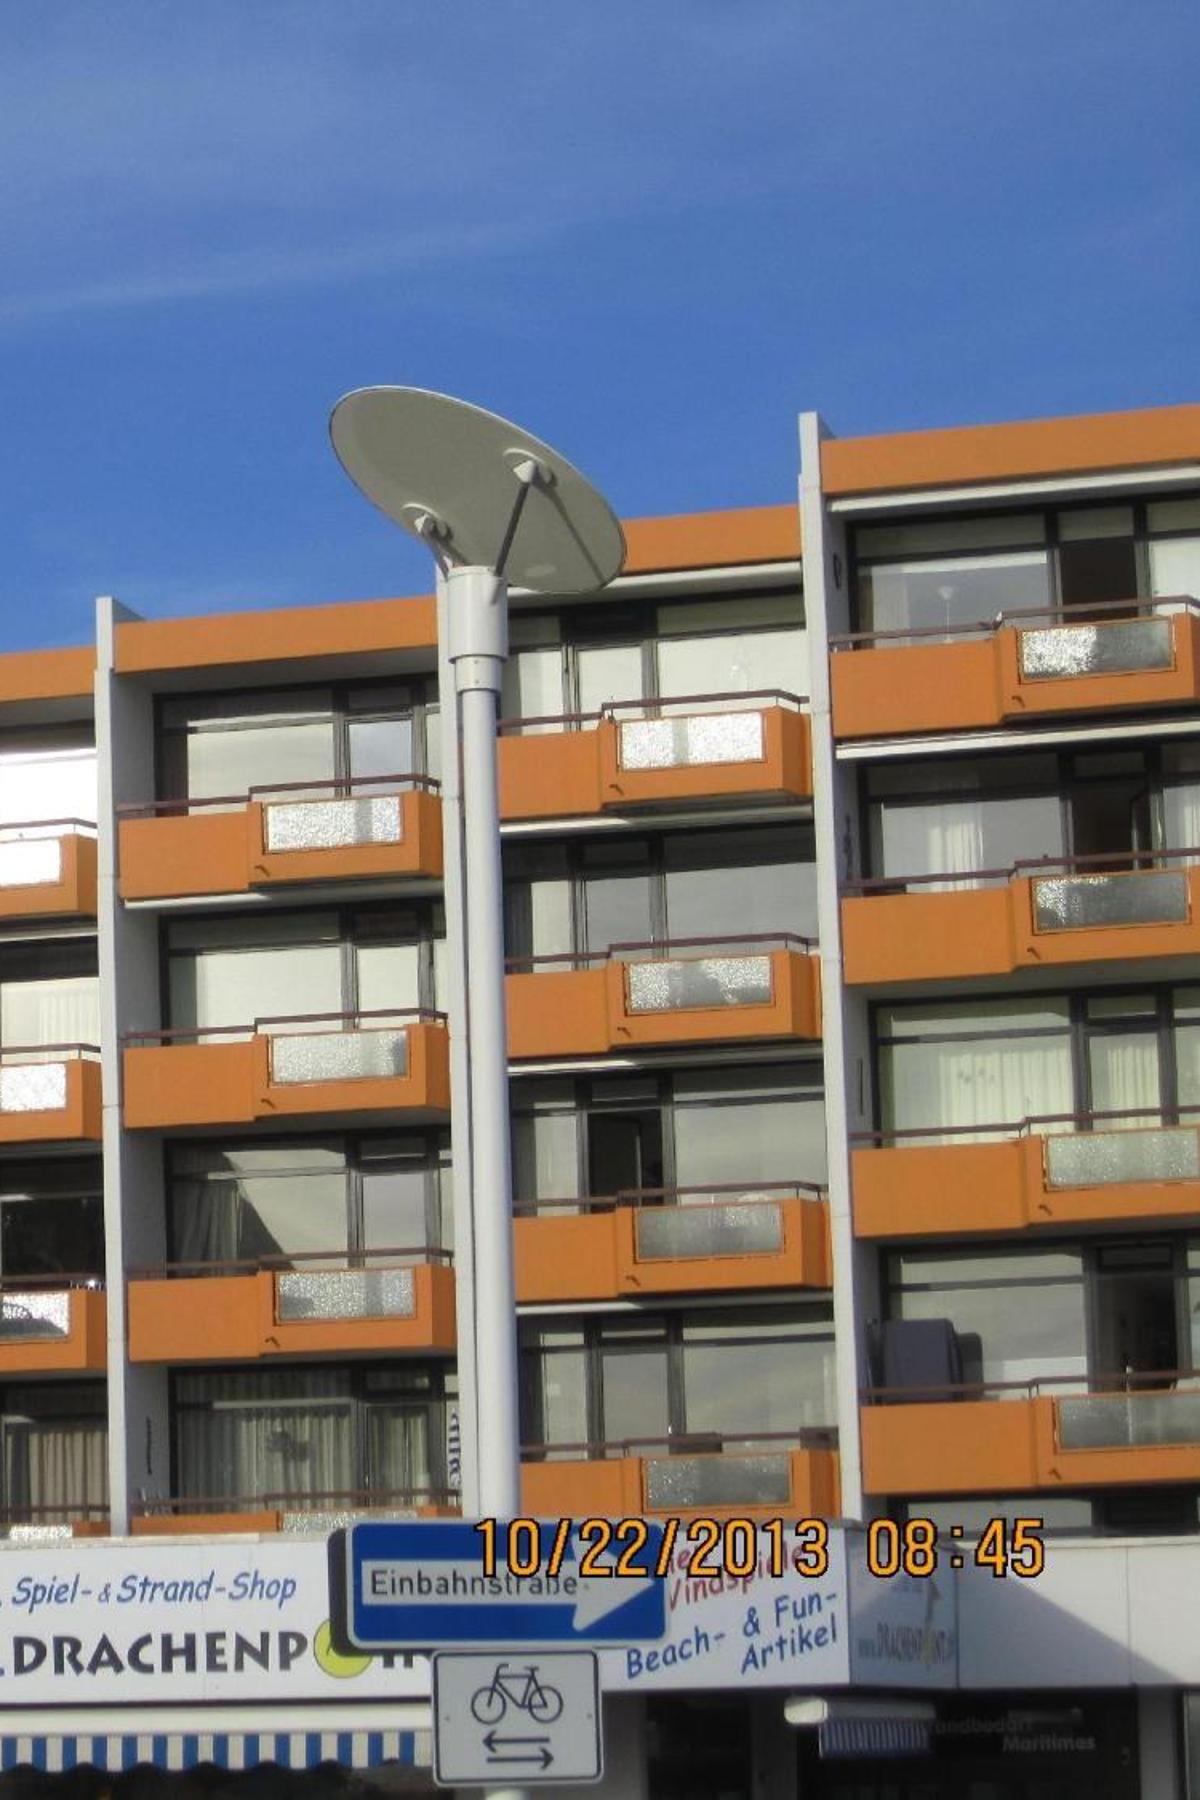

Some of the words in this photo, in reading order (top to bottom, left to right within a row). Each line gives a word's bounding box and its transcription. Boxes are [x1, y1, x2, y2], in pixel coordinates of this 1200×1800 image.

[11, 1573, 92, 1614] Spiel-
[116, 1568, 297, 1610] Strand-Shop
[626, 1624, 727, 1680] Beach-
[743, 1606, 761, 1638] &
[774, 1592, 838, 1628] Fun-
[740, 1612, 838, 1675] Artikel
